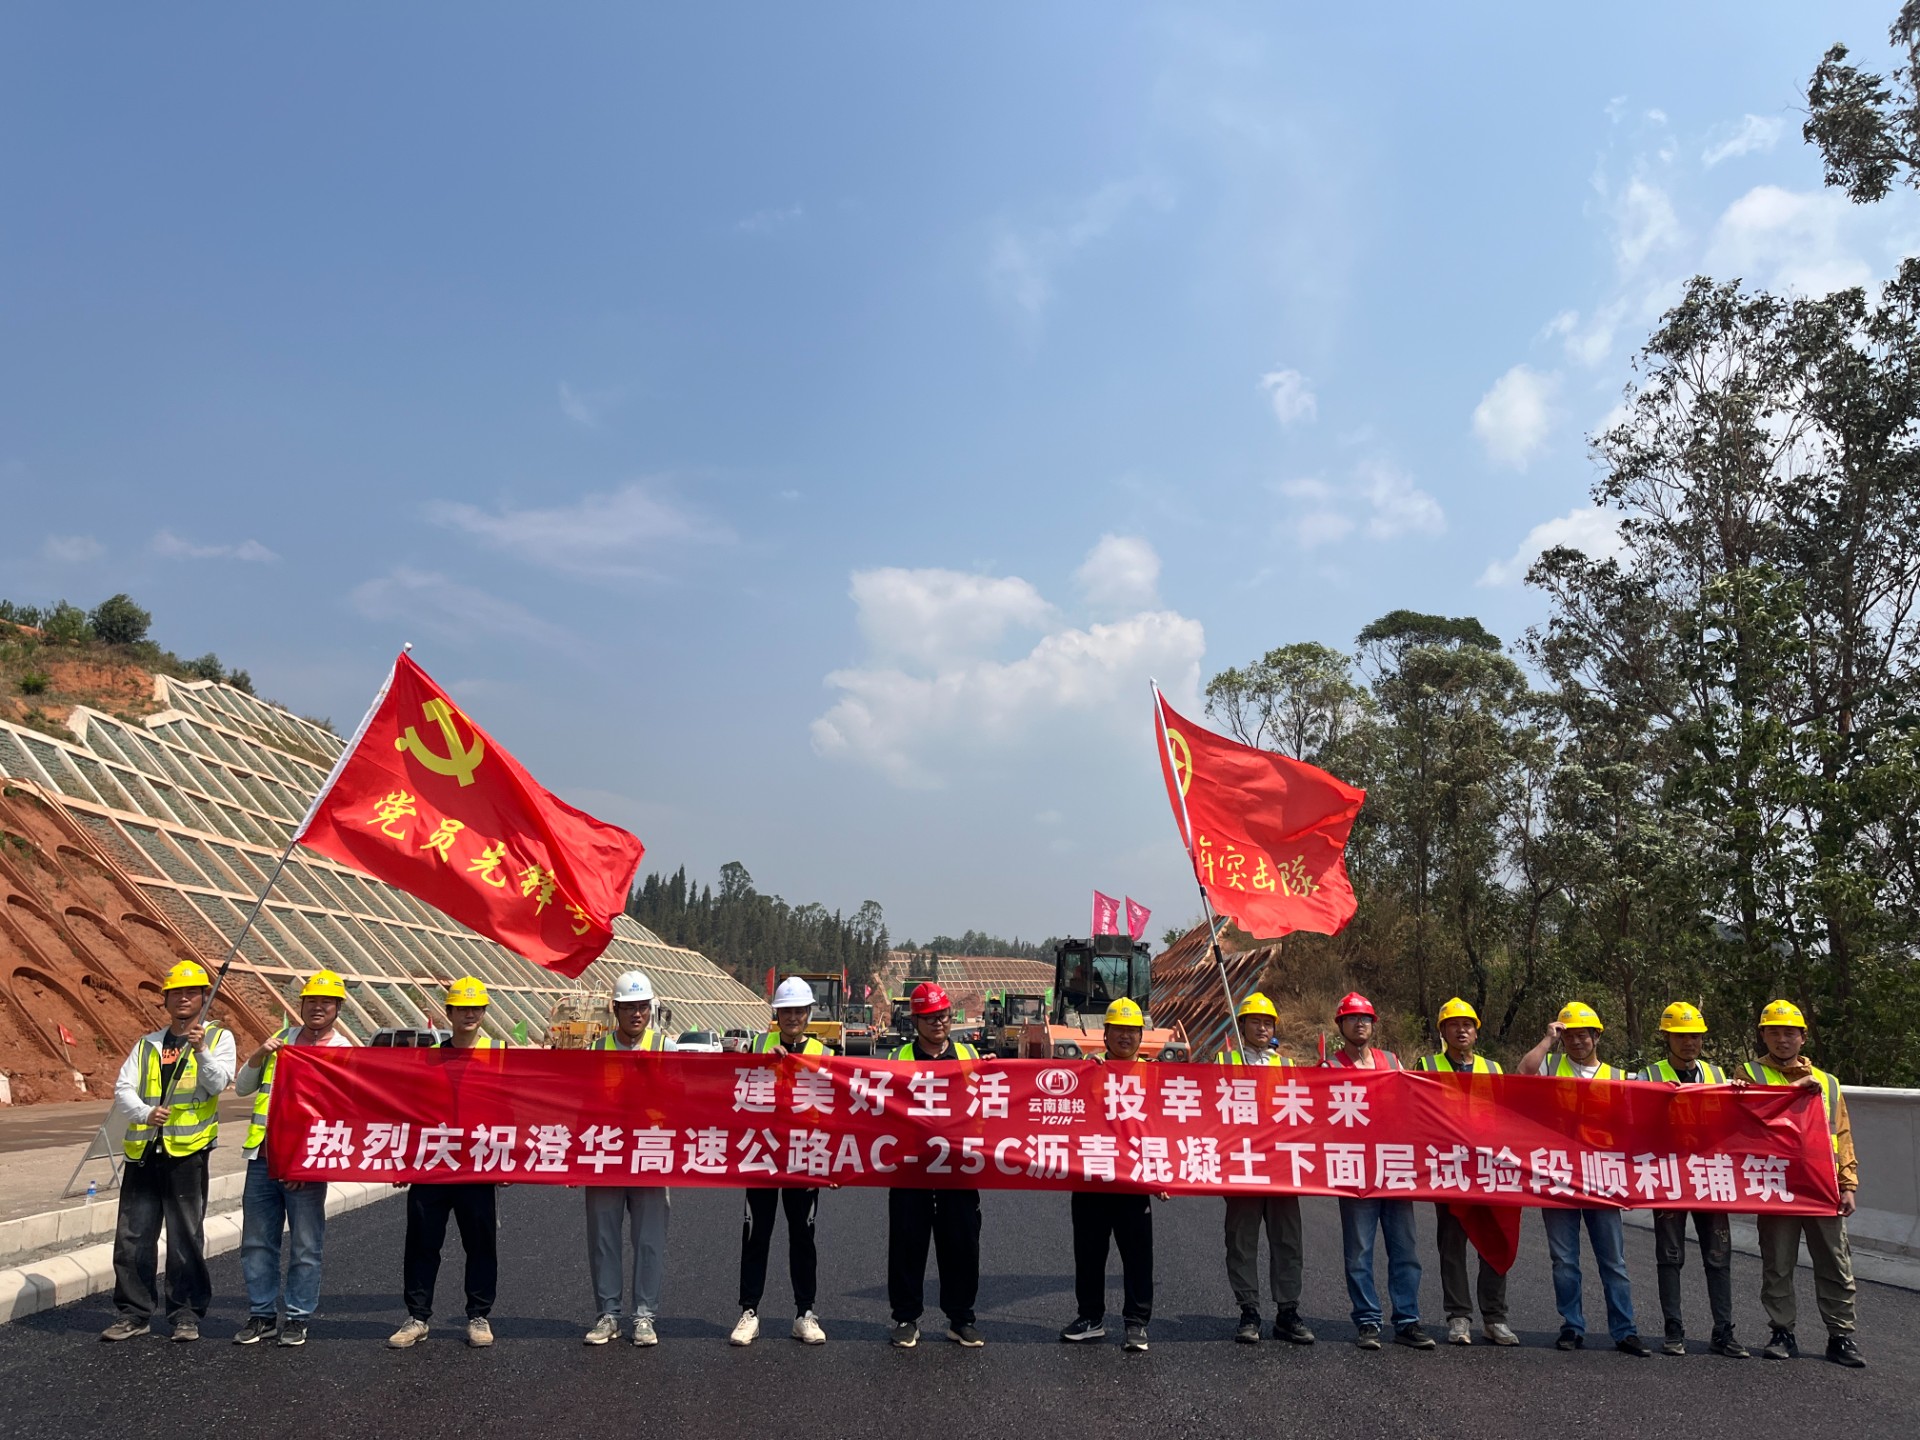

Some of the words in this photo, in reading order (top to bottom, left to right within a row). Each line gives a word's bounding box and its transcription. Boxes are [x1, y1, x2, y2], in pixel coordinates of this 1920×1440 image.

[732, 1066, 1011, 1119] 建美好生活
[1103, 1073, 1371, 1129] 投幸福未来
[1028, 1097, 1086, 1114] 云南建投
[1041, 1115, 1073, 1125] YCIH
